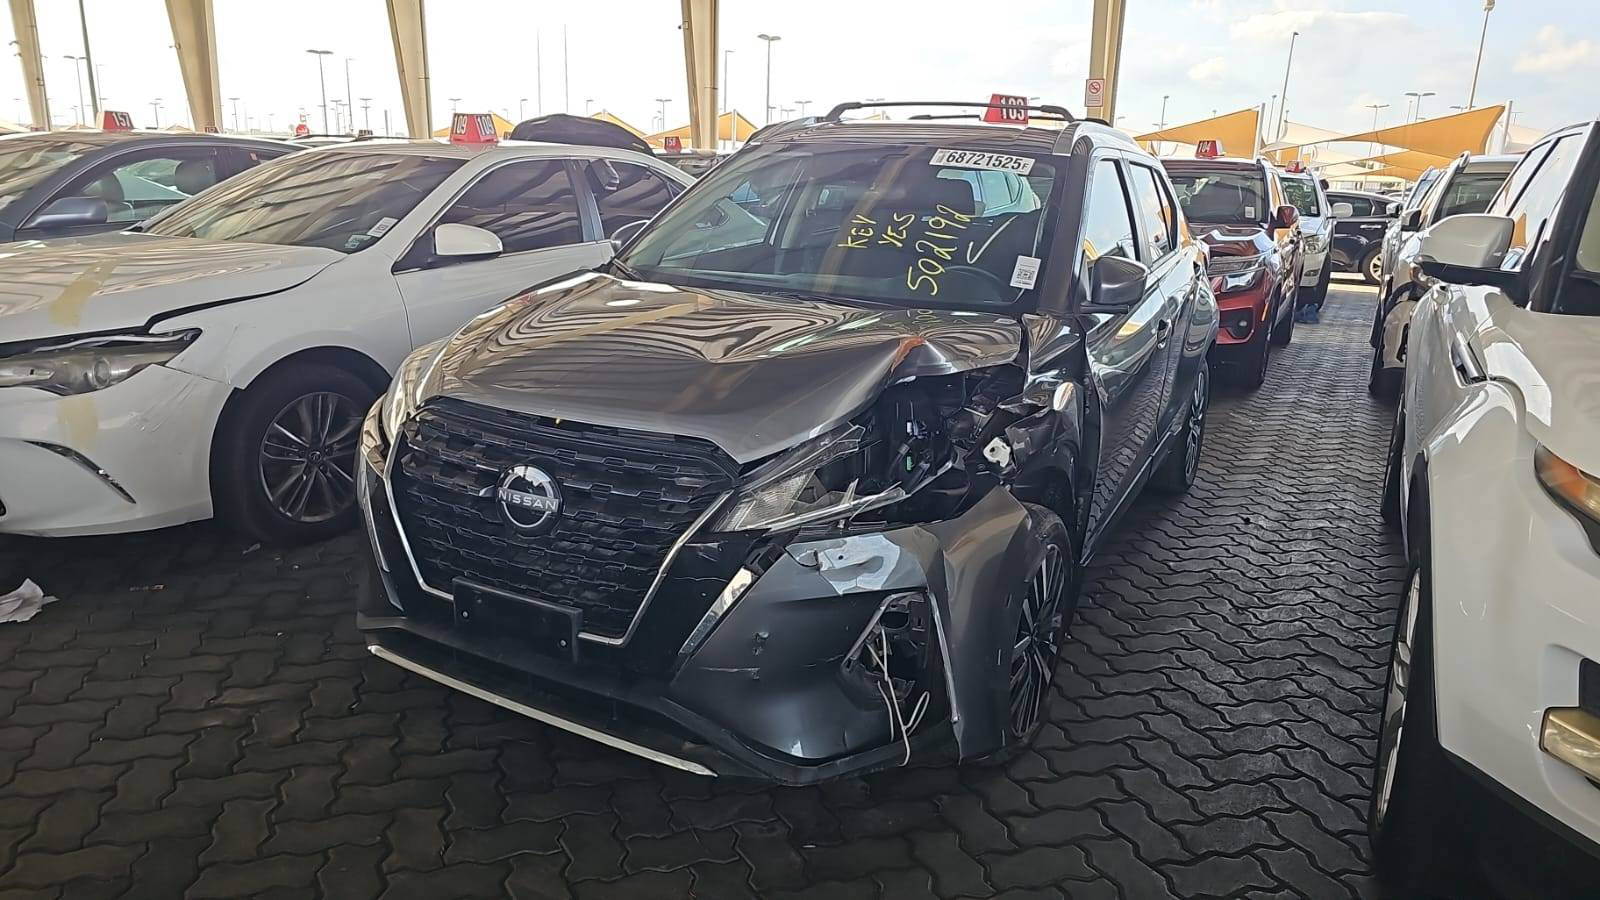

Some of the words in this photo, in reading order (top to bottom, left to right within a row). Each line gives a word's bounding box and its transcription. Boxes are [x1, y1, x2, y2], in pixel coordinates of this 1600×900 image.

[1000, 97, 1025, 120] 103
[112, 112, 131, 128] 157
[453, 115, 468, 135] 109
[477, 116, 495, 136] 109
[838, 214, 877, 248] KEY
[878, 212, 915, 247] YES
[907, 204, 972, 295] 502192
[498, 490, 556, 510] NISSAN
